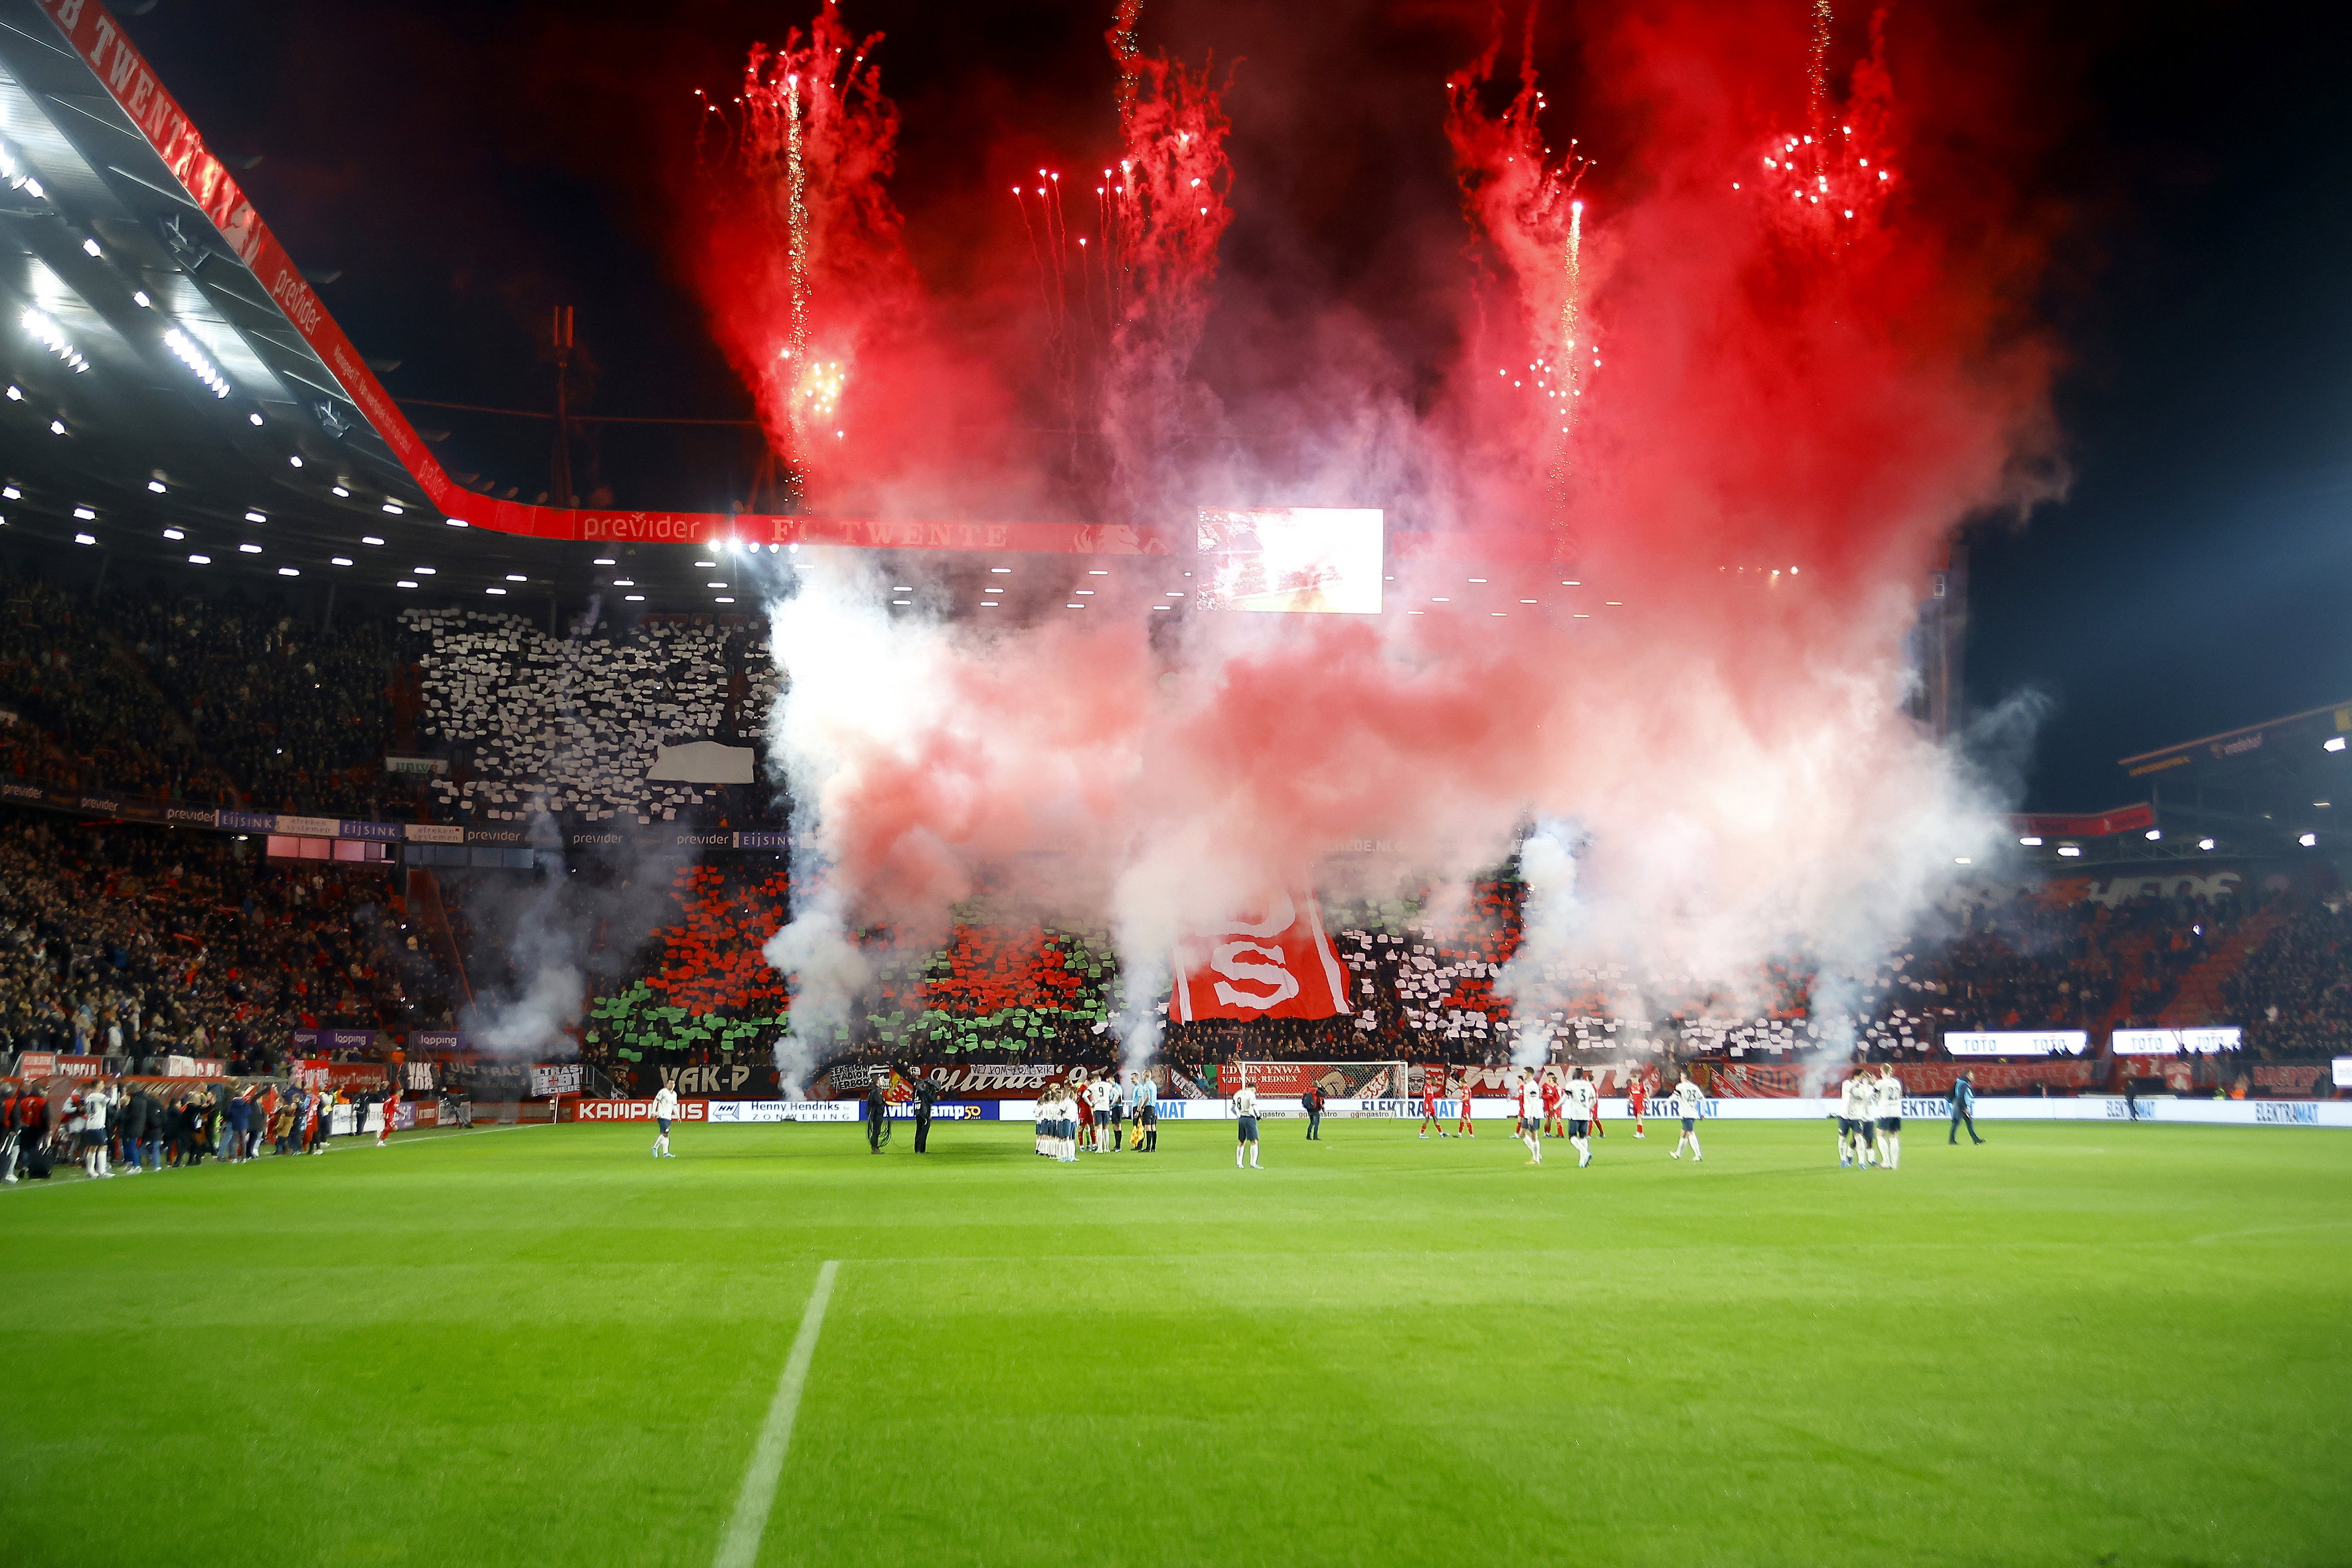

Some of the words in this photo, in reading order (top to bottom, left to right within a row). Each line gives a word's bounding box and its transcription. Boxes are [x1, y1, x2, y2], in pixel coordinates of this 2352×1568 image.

[273, 269, 321, 335] previder
[584, 514, 700, 540] previder
[839, 520, 1007, 548] TWENTE
[167, 808, 216, 823] previder
[467, 830, 521, 842] previder
[573, 833, 623, 845] previder
[677, 833, 729, 845] previder
[335, 1033, 366, 1046] looping
[421, 1034, 458, 1047] looping
[1964, 1040, 1996, 1052] TOTO
[2032, 1039, 2066, 1052] TOTO
[2131, 1037, 2163, 1050] TOTO
[408, 1062, 432, 1077] VAK
[1221, 1065, 1262, 1075] EDWIN
[1264, 1065, 1302, 1074] YNWA
[659, 1065, 750, 1095] VAK-P
[1098, 1086, 1104, 1097] 9
[1580, 1089, 1586, 1102] 3
[751, 1101, 786, 1112] Henny
[790, 1101, 839, 1111] Hendriks
[1236, 1096, 1242, 1111] 8
[888, 1102, 964, 1119] wildamp
